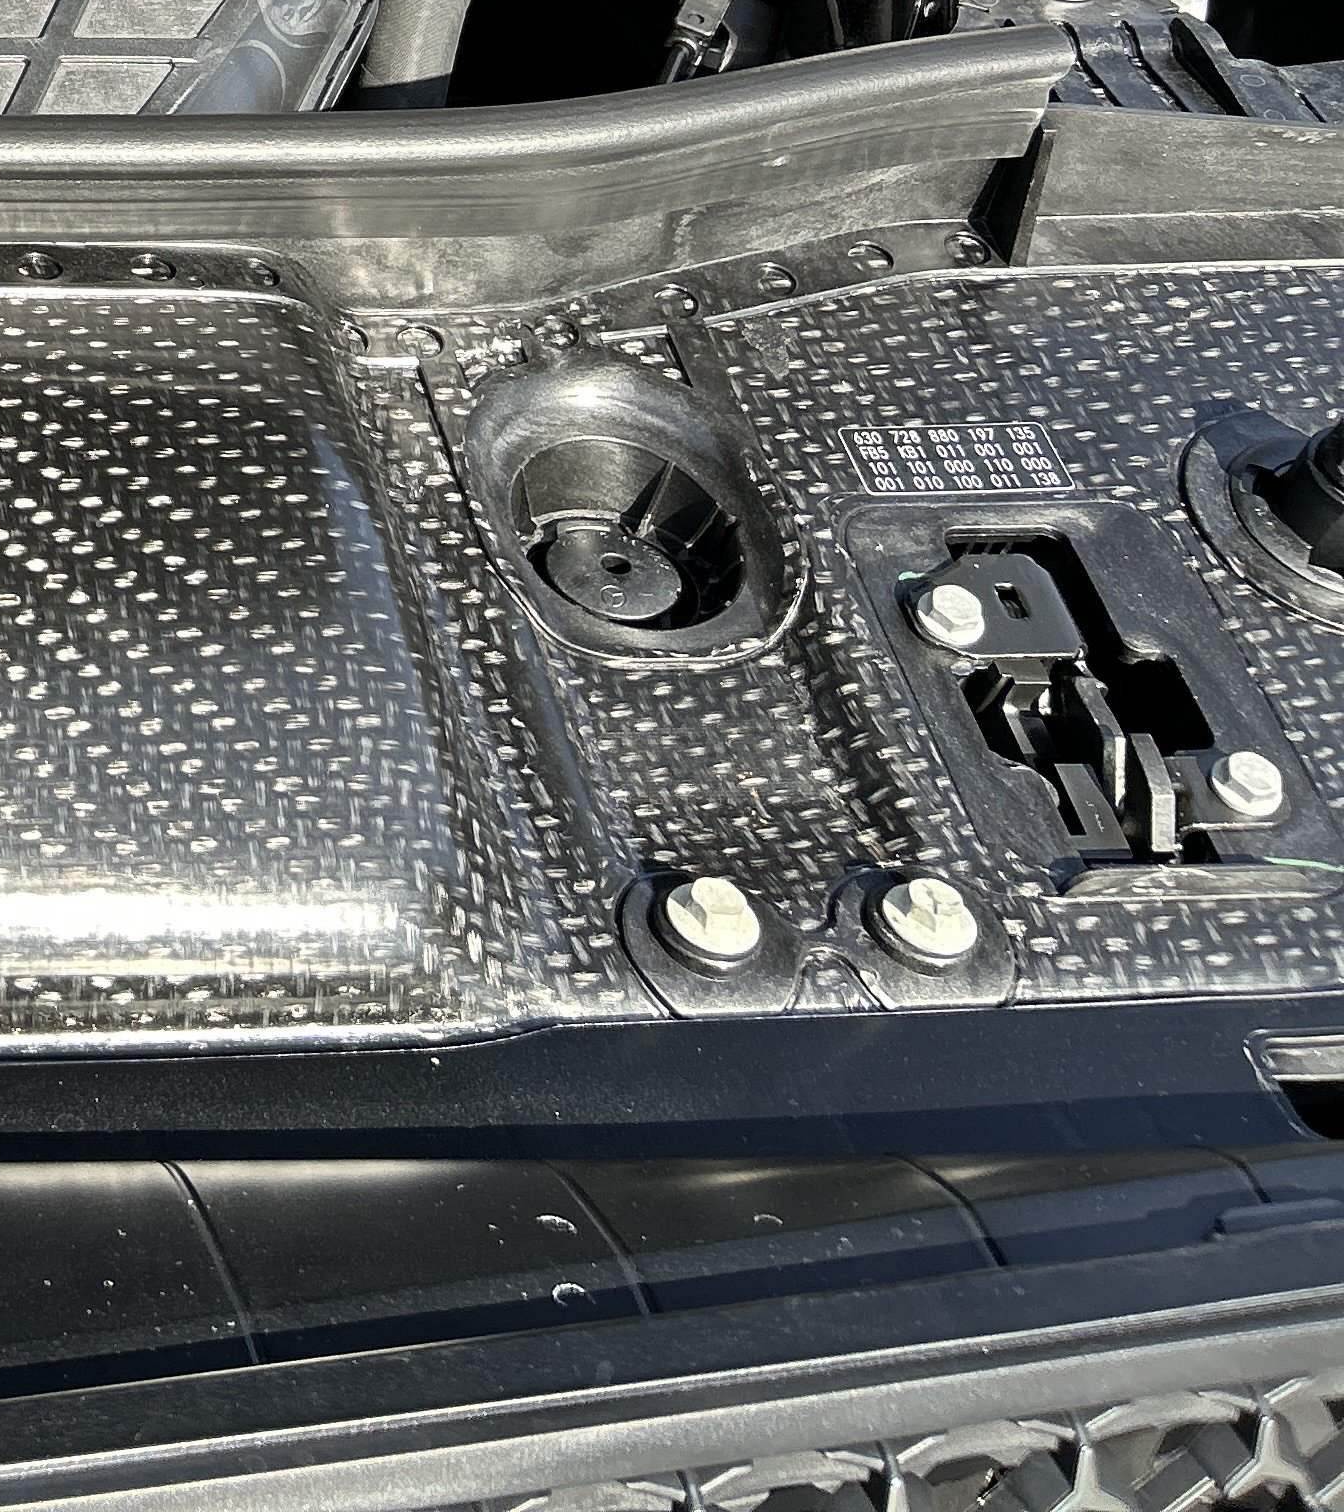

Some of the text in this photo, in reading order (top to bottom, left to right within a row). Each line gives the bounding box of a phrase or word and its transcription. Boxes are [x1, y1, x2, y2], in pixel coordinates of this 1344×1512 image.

[853, 426, 1037, 446] 630 728 880 197 135
[858, 441, 1044, 461] FB5 KB1 011 001 001
[868, 456, 1052, 476] 101 101 000 110 000
[874, 471, 1061, 491] 001 010 100 011 138
